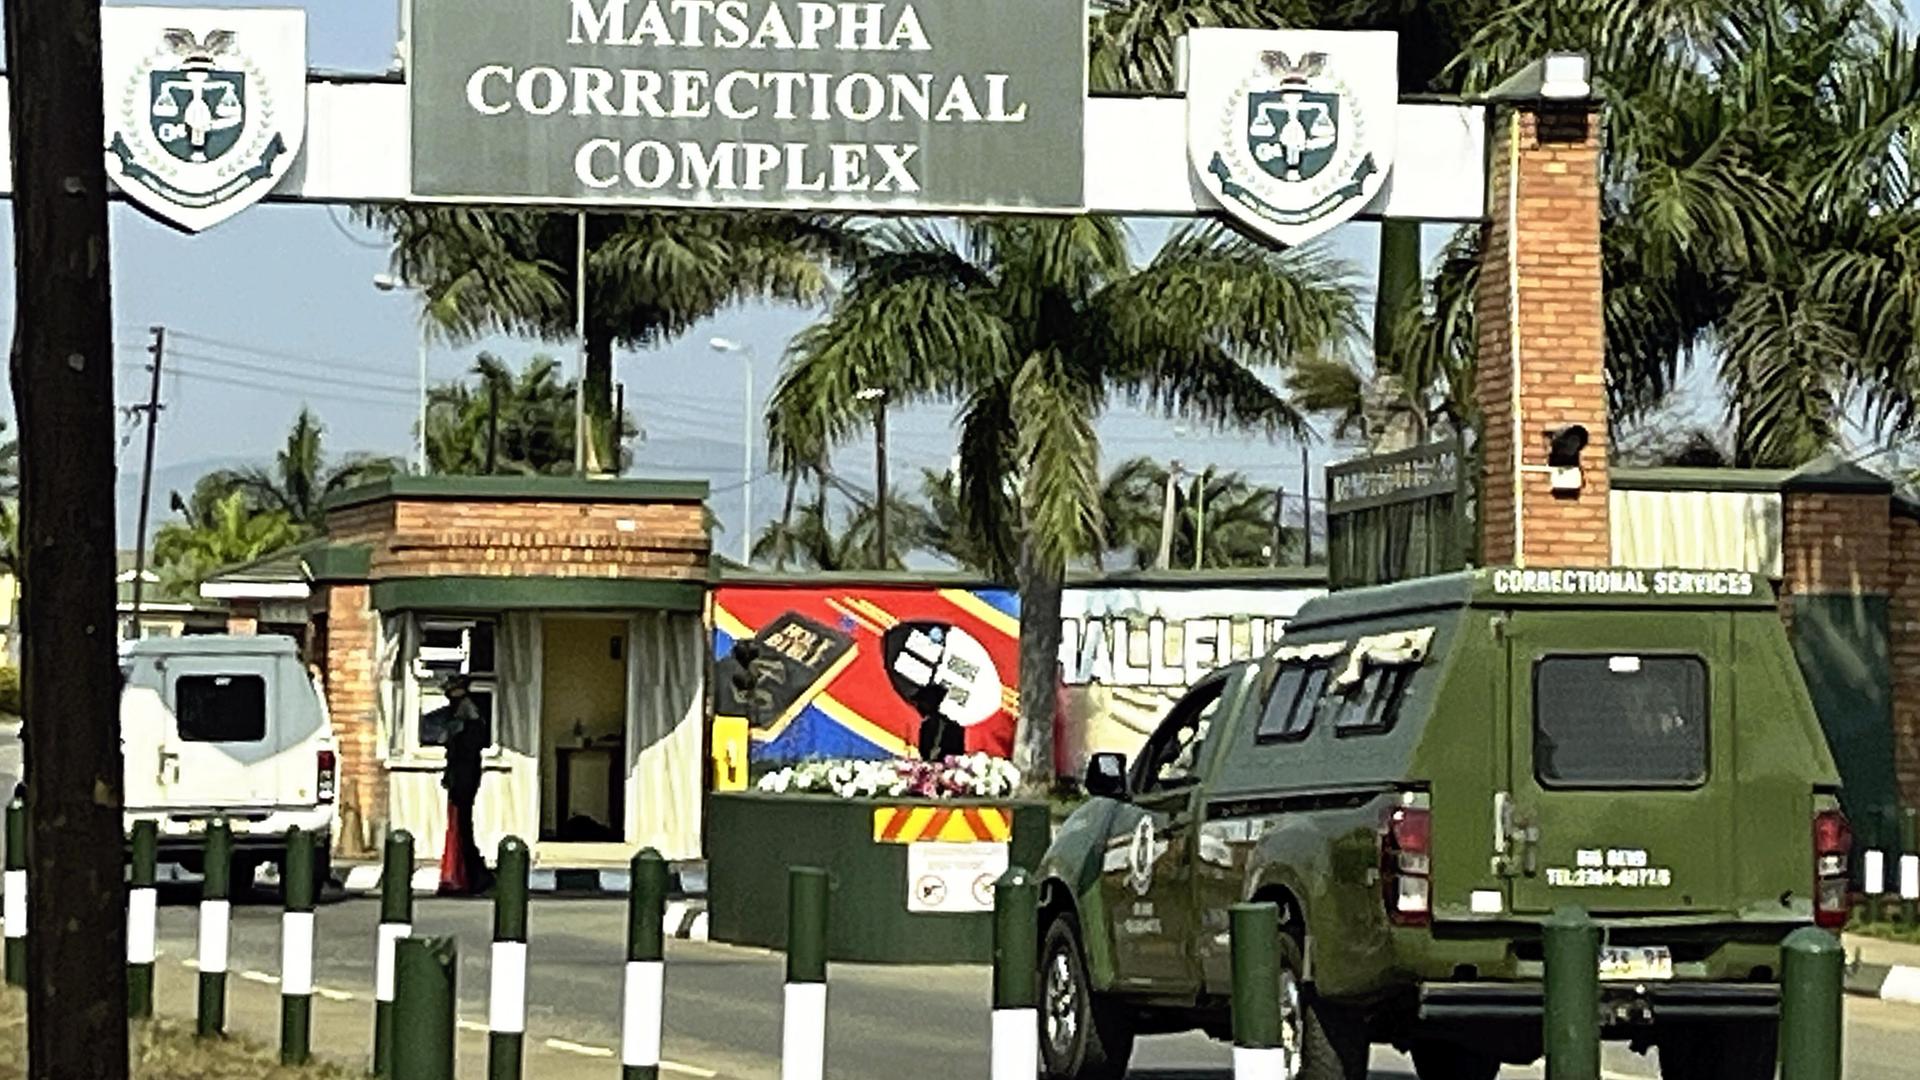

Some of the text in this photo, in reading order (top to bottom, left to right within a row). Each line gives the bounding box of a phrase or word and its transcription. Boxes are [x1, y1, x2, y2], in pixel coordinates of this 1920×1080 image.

[566, 0, 932, 51] MATSAPHA
[466, 65, 1026, 122] CORRECTIONAL
[574, 138, 920, 192] COMPLEX
[1494, 569, 1753, 595] CORRECTIONAL SERVICES
